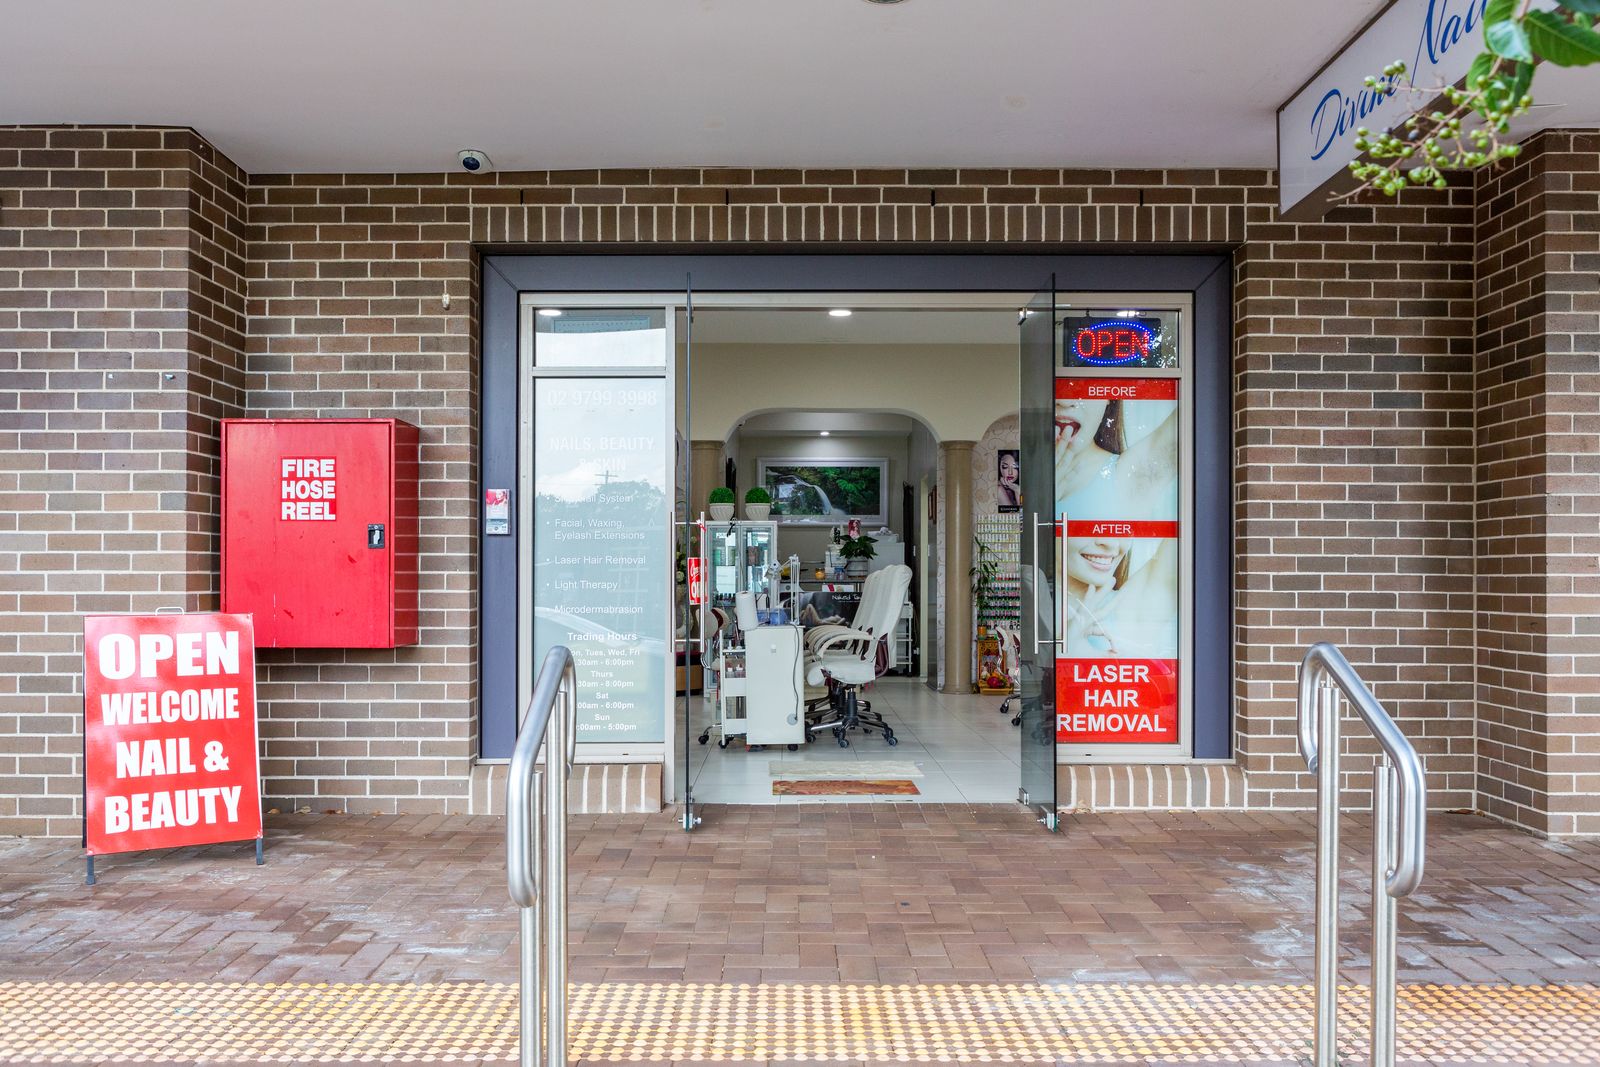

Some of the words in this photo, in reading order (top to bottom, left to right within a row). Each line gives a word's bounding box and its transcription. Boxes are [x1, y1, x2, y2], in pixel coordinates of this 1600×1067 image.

[1410, 0, 1488, 93] Nai
[1077, 330, 1149, 358] OPEN
[547, 389, 567, 406] 02
[571, 389, 611, 406] 9799
[618, 389, 657, 406] 3998
[1088, 386, 1136, 397] BEFORE
[600, 436, 654, 451] BEAUTY
[282, 458, 335, 478] FIRE
[593, 458, 626, 471] SKIN
[281, 479, 335, 500] HOSE
[599, 493, 634, 504] System
[281, 503, 335, 521] REEL
[554, 518, 585, 529] Facial,
[588, 518, 625, 529] Waxing,
[1092, 524, 1131, 534] AFTER
[554, 530, 592, 542] Eyelash
[594, 530, 646, 540] Extensions
[554, 555, 581, 565] Laser
[583, 555, 603, 565] Hair
[605, 555, 646, 565] Removal
[554, 580, 578, 590] Light
[580, 580, 618, 591] Therapy
[554, 604, 643, 614] Microdermabrasion
[567, 632, 605, 642] Trading
[607, 632, 637, 641] Hours
[98, 631, 239, 680] OPEN
[586, 649, 606, 657] Tues,
[608, 649, 627, 657] Wed,
[605, 658, 634, 667] 6:00pm
[591, 670, 614, 678] Thurs
[1073, 664, 1150, 683] LASER
[1084, 689, 1139, 708] HAIR
[101, 687, 239, 726] WELCOME
[576, 701, 598, 709] :00am
[605, 701, 634, 710] 6:00pm
[594, 713, 610, 721] Sun
[1057, 713, 1167, 732] REMOVAL
[608, 723, 637, 732] 5:00pm
[115, 737, 196, 779] NAIL
[203, 740, 230, 772] &
[104, 786, 242, 834] BEAUTY
